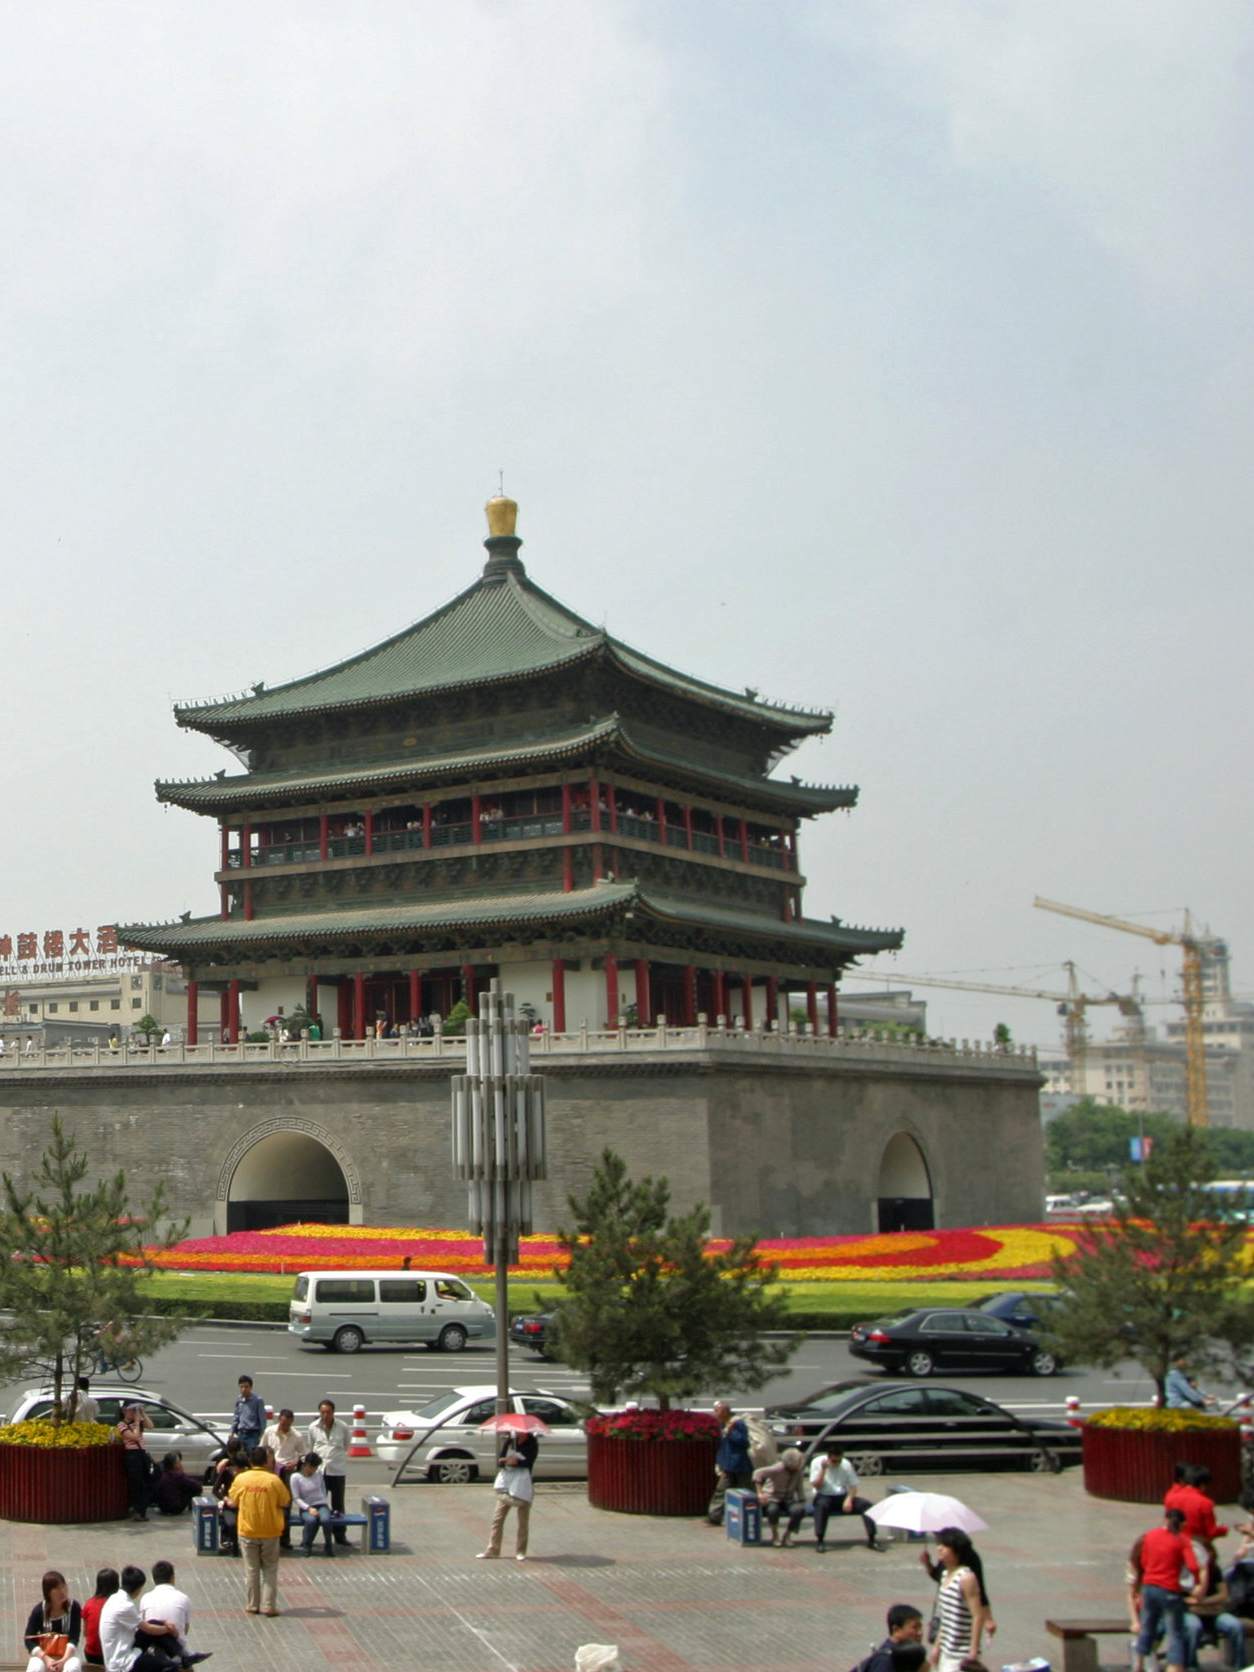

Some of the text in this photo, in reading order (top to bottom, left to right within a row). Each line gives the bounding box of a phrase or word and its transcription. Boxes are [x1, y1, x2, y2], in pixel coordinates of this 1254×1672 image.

[21, 964, 29, 975] &
[33, 962, 64, 974] DRUM
[68, 958, 106, 971] TOWER
[110, 955, 146, 968] HOTEL
